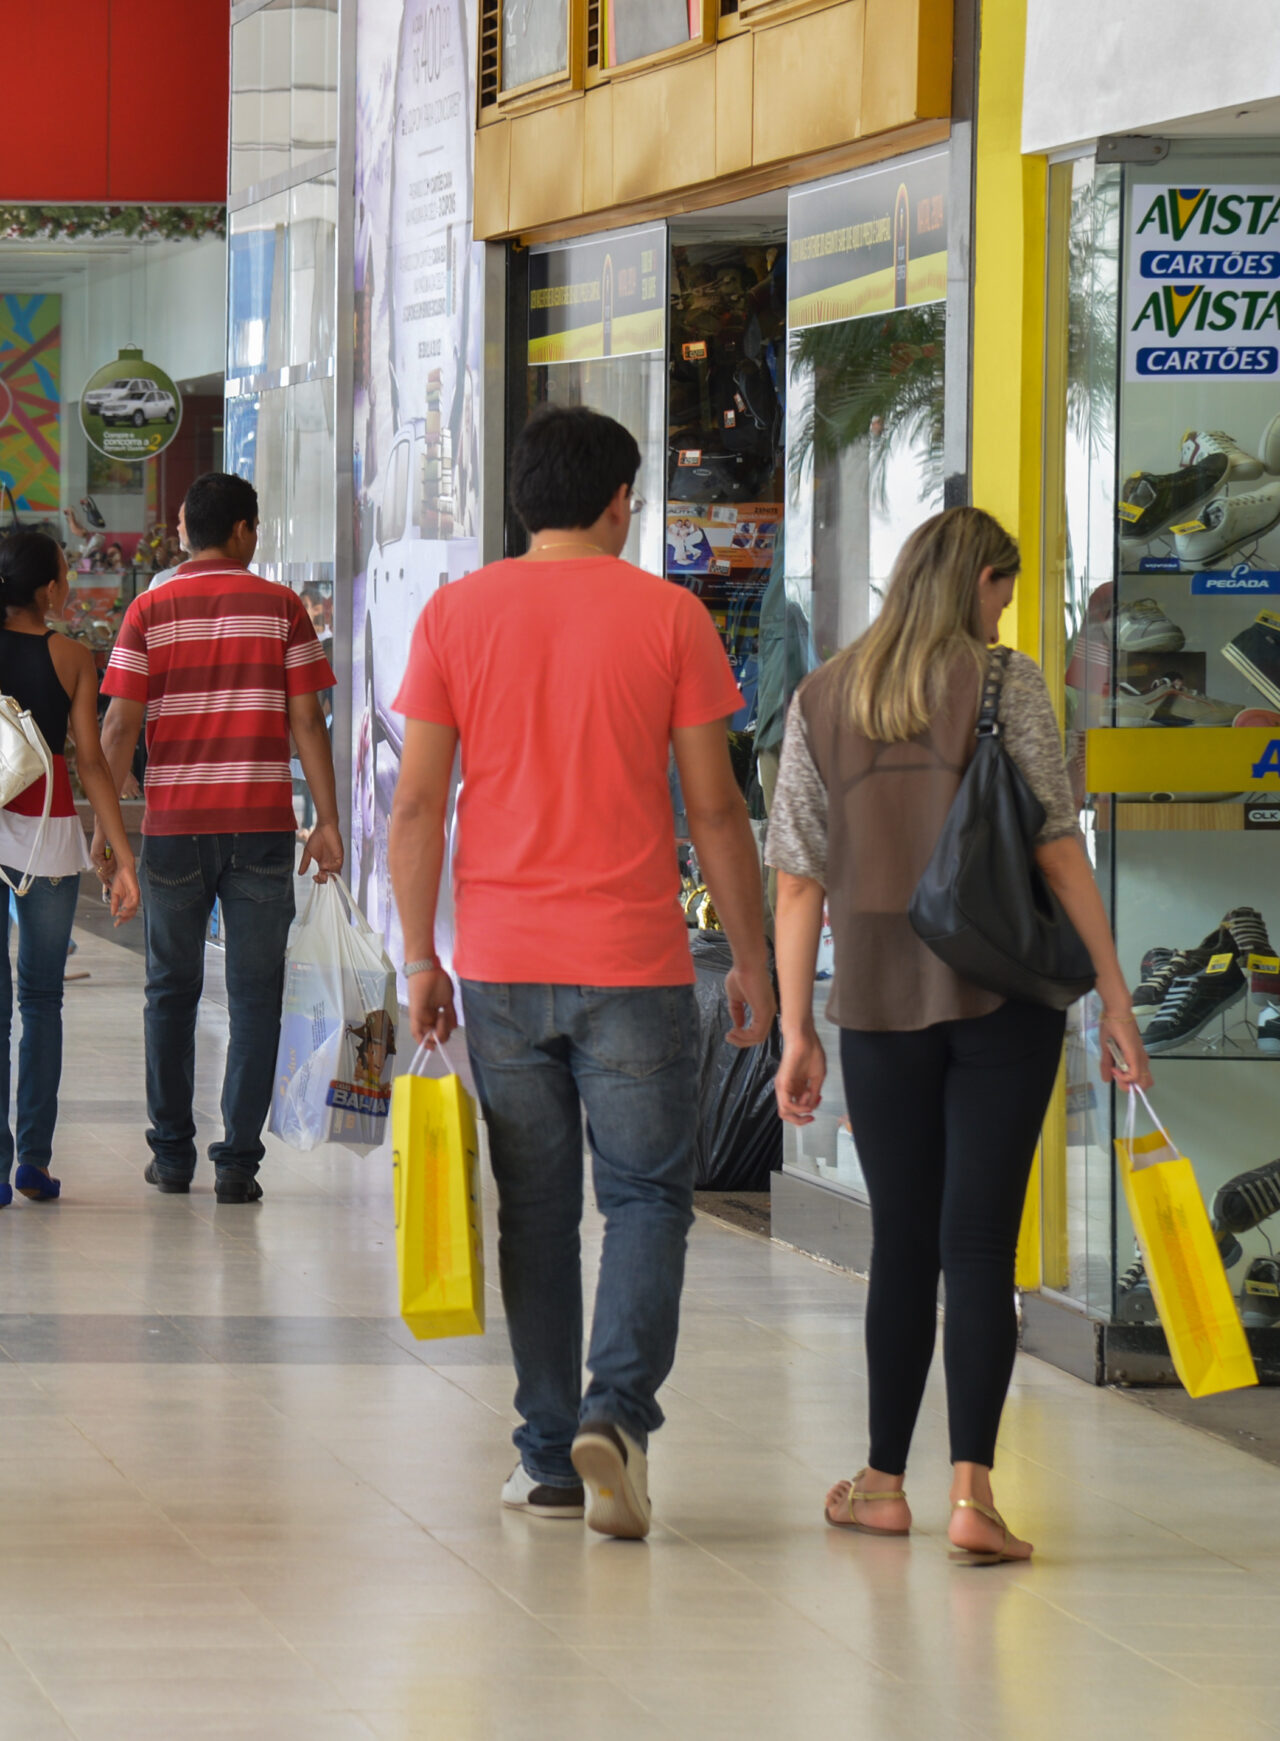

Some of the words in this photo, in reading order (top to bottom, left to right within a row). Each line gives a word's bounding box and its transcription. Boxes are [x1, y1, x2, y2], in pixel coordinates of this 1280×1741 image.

[1136, 188, 1280, 241] AVISTA
[1150, 250, 1275, 275] CARTÕES
[1131, 285, 1280, 338] AVISTA
[1146, 347, 1271, 371] CARTÕES
[147, 434, 162, 451] 2
[1206, 579, 1269, 588] PEGADA
[333, 1089, 387, 1113] BAHIA
